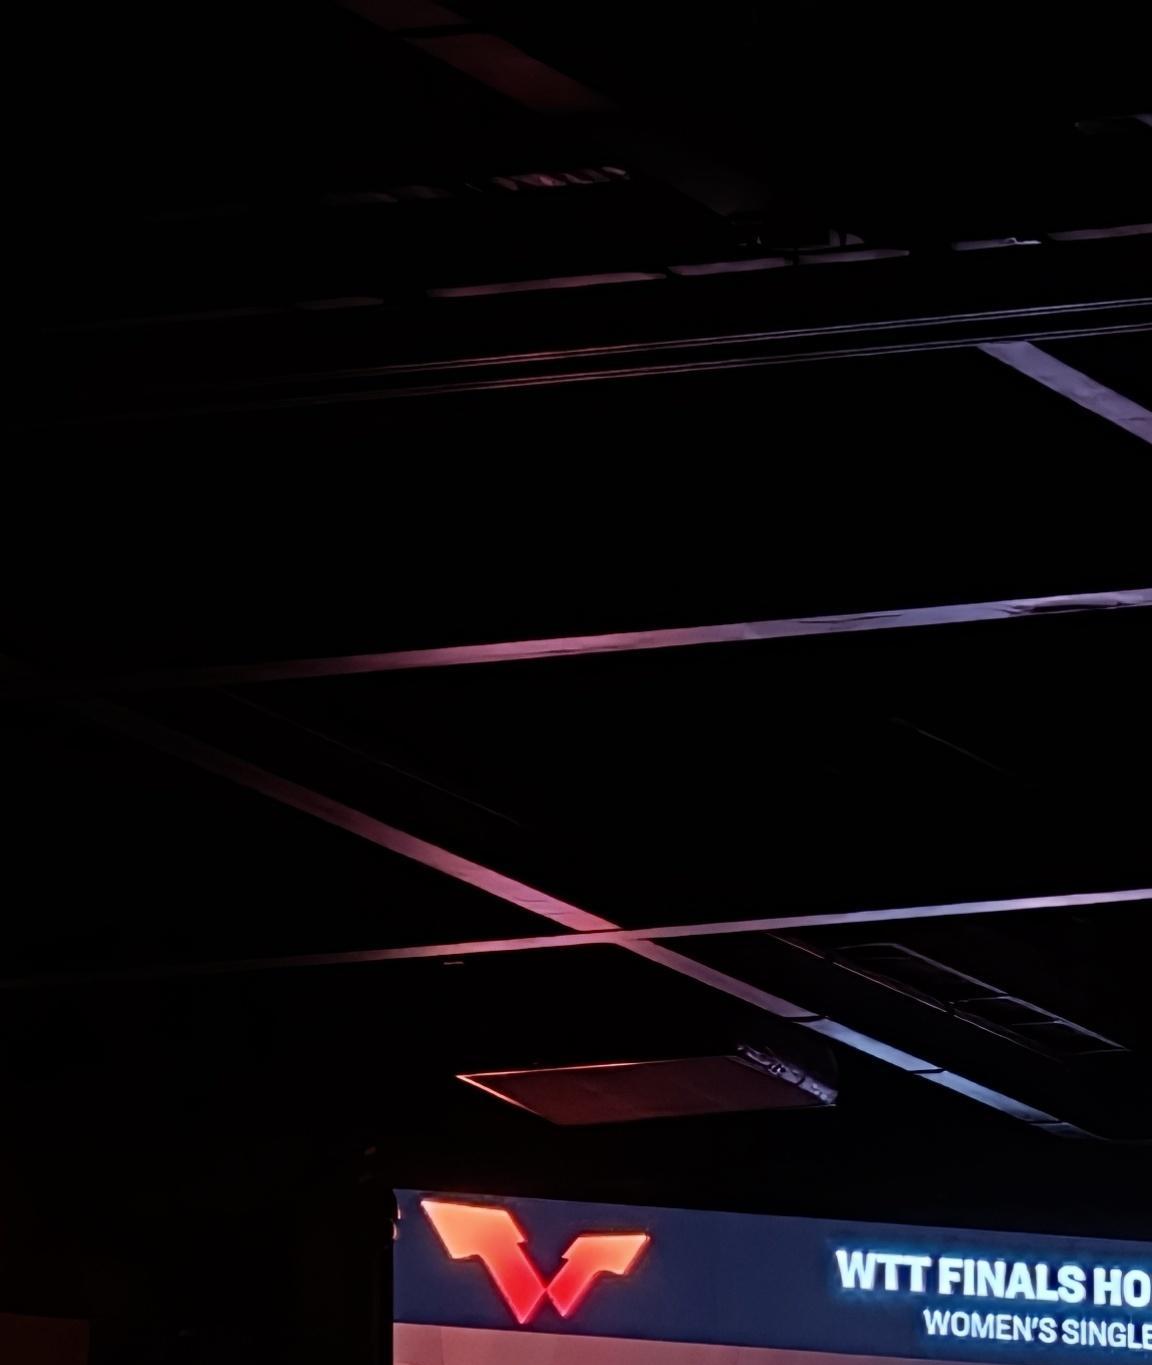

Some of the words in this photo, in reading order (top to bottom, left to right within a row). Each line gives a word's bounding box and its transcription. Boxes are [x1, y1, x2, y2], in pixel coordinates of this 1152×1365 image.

[836, 1249, 931, 1291] WTT
[938, 1258, 1085, 1303] FINALS
[924, 1308, 1057, 1343] WOMEN'S
